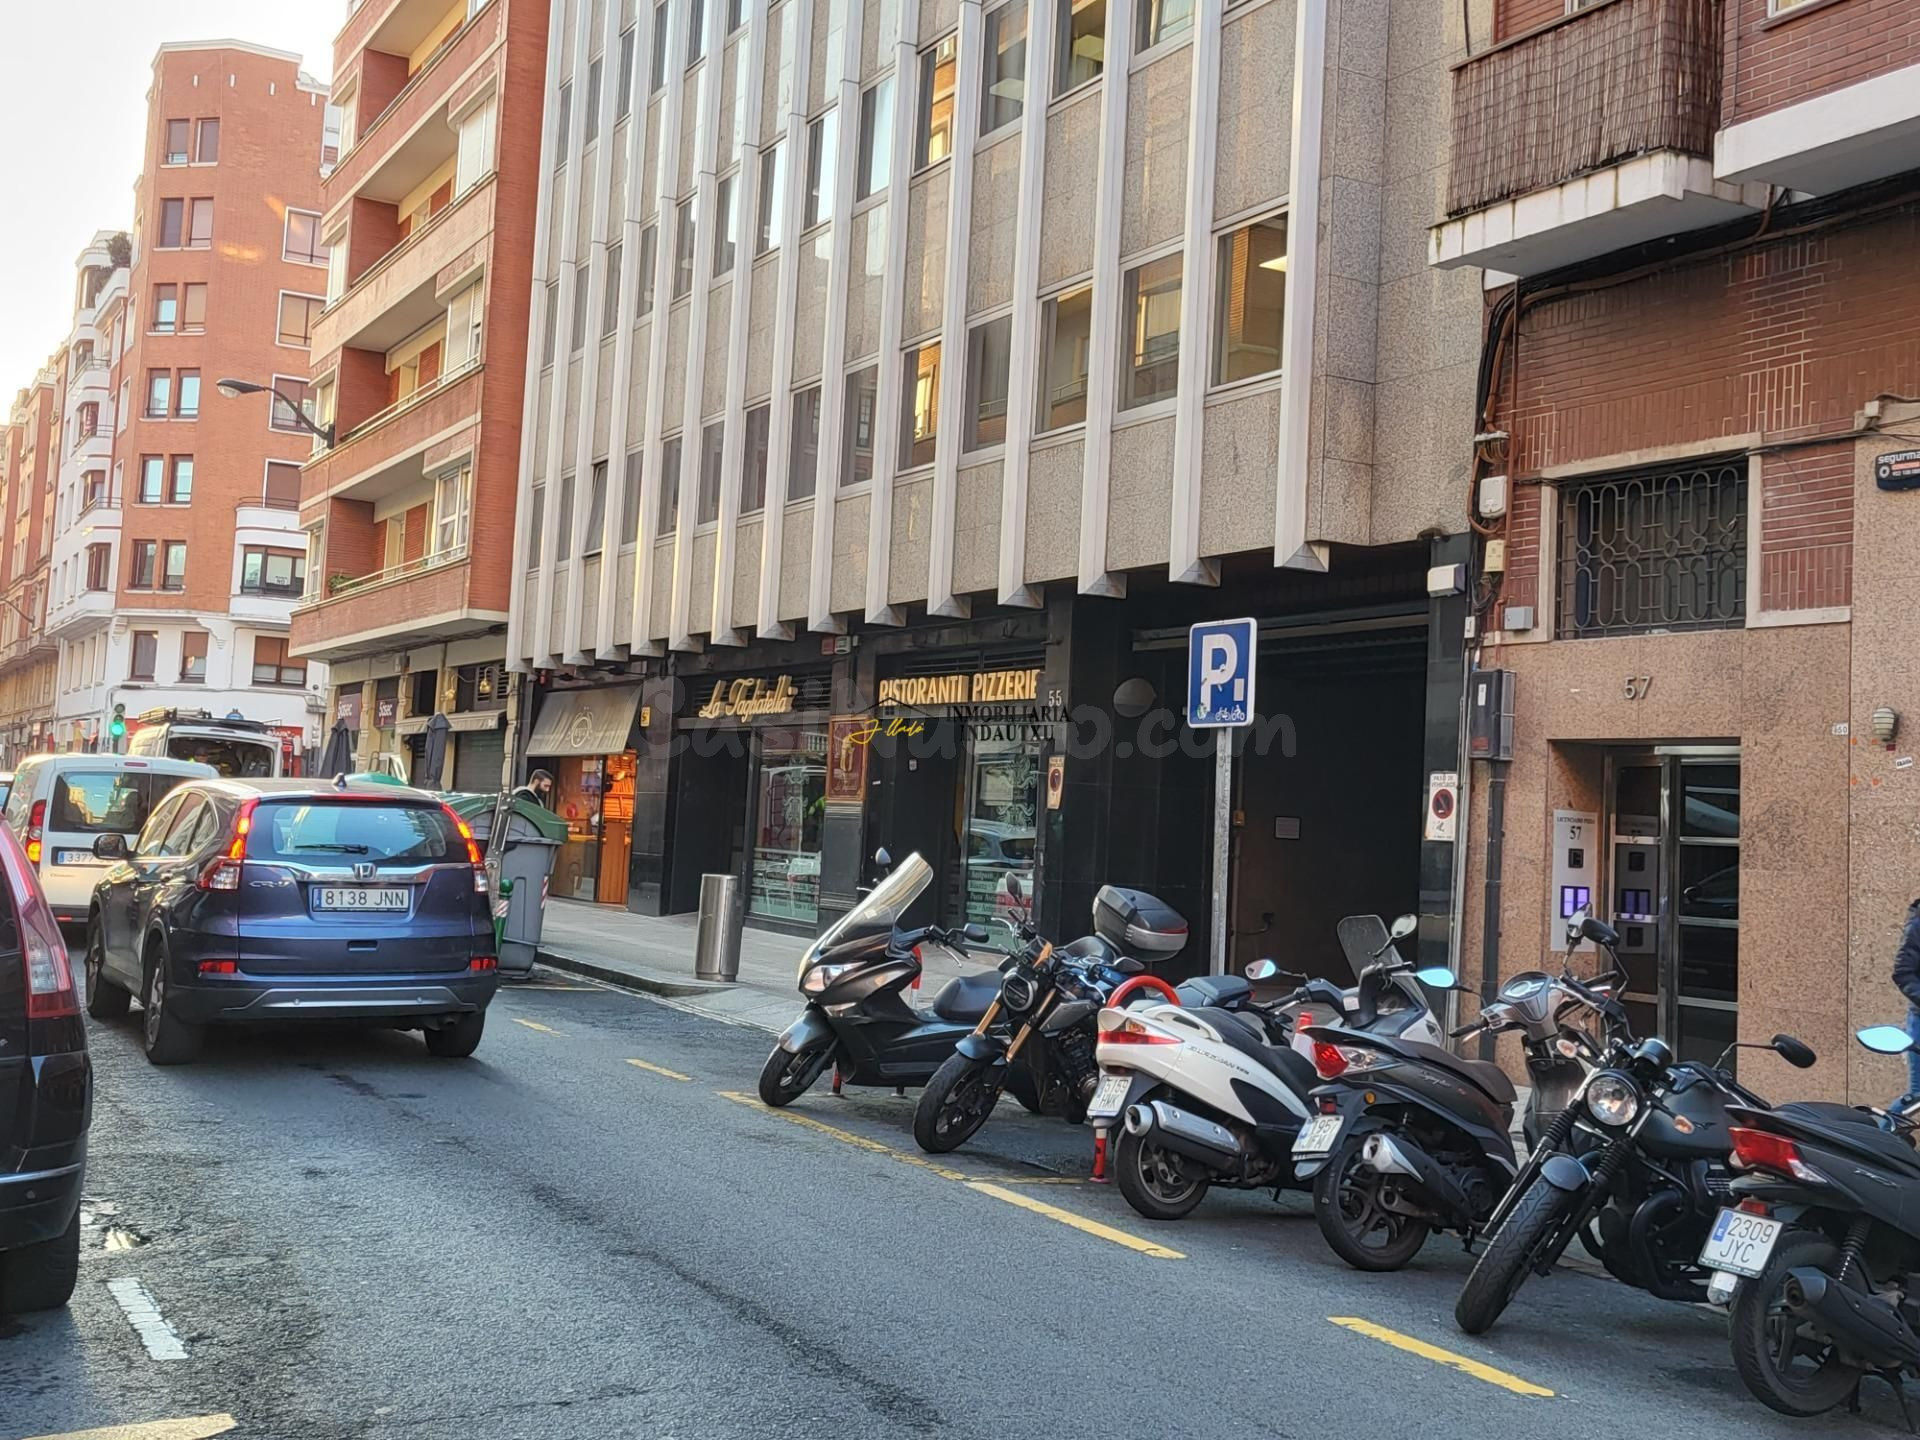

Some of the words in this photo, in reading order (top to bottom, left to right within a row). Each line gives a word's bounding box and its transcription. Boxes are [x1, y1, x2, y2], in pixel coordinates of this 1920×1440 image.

[1201, 633, 1238, 712] P
[699, 680, 725, 719] La
[726, 675, 791, 723] Tagliatella
[879, 675, 969, 707] RISTORANTI
[972, 669, 1041, 702] PIZZERIE
[1048, 690, 1062, 707] 55
[1624, 676, 1652, 699] 57
[1569, 825, 1582, 840] 57
[325, 890, 368, 906] 8138
[374, 891, 405, 907] JNN
[1727, 1217, 1775, 1244] 2309
[1720, 1239, 1755, 1265] JYC
